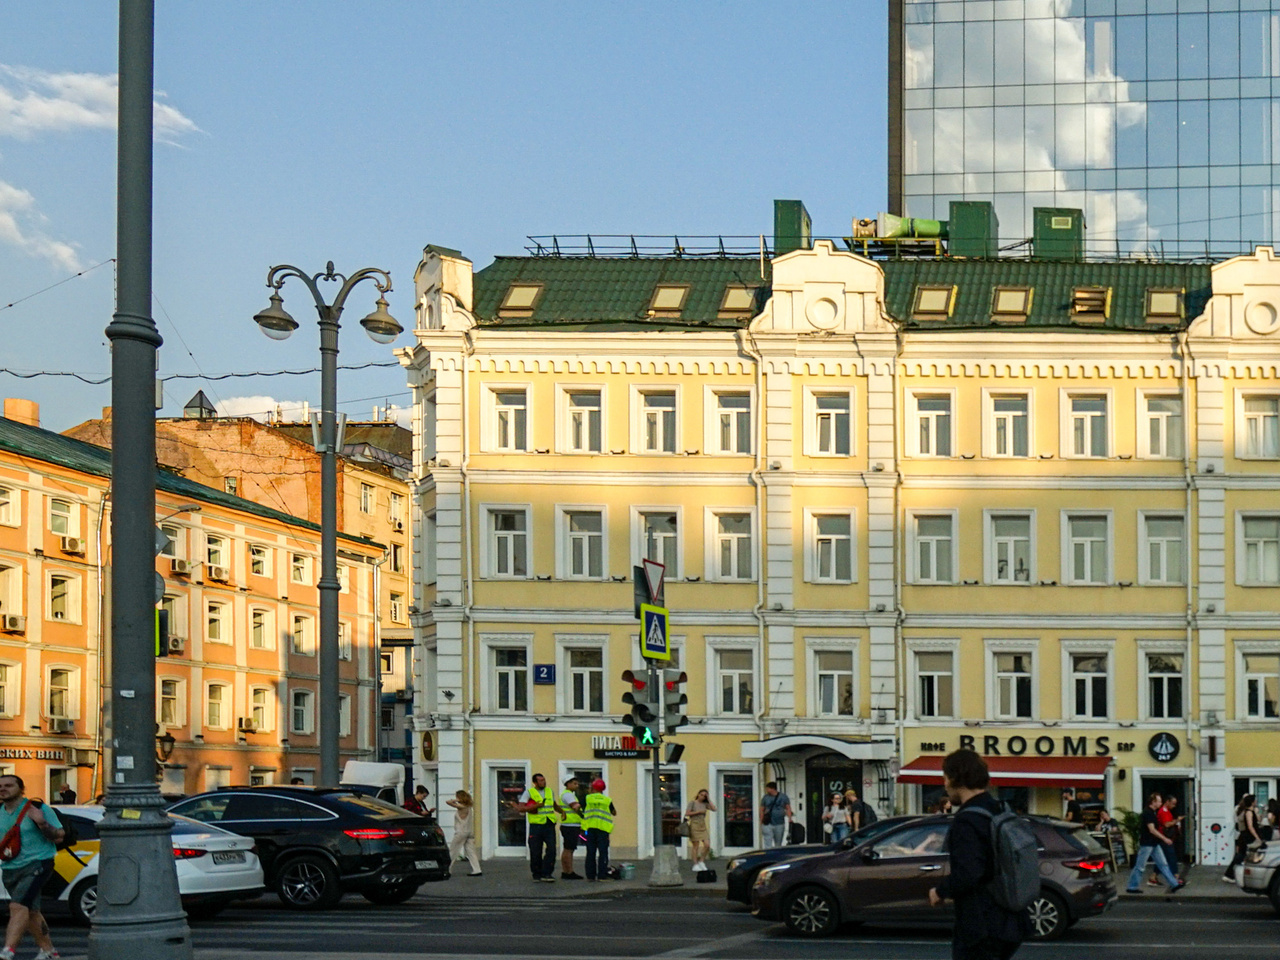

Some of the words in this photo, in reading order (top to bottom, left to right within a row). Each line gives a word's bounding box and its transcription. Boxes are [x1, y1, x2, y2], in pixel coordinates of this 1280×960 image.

[540, 667, 548, 678] 2
[959, 734, 1110, 756] BROOMS
[1117, 742, 1136, 752] БАР
[36, 750, 64, 760] ВИН
